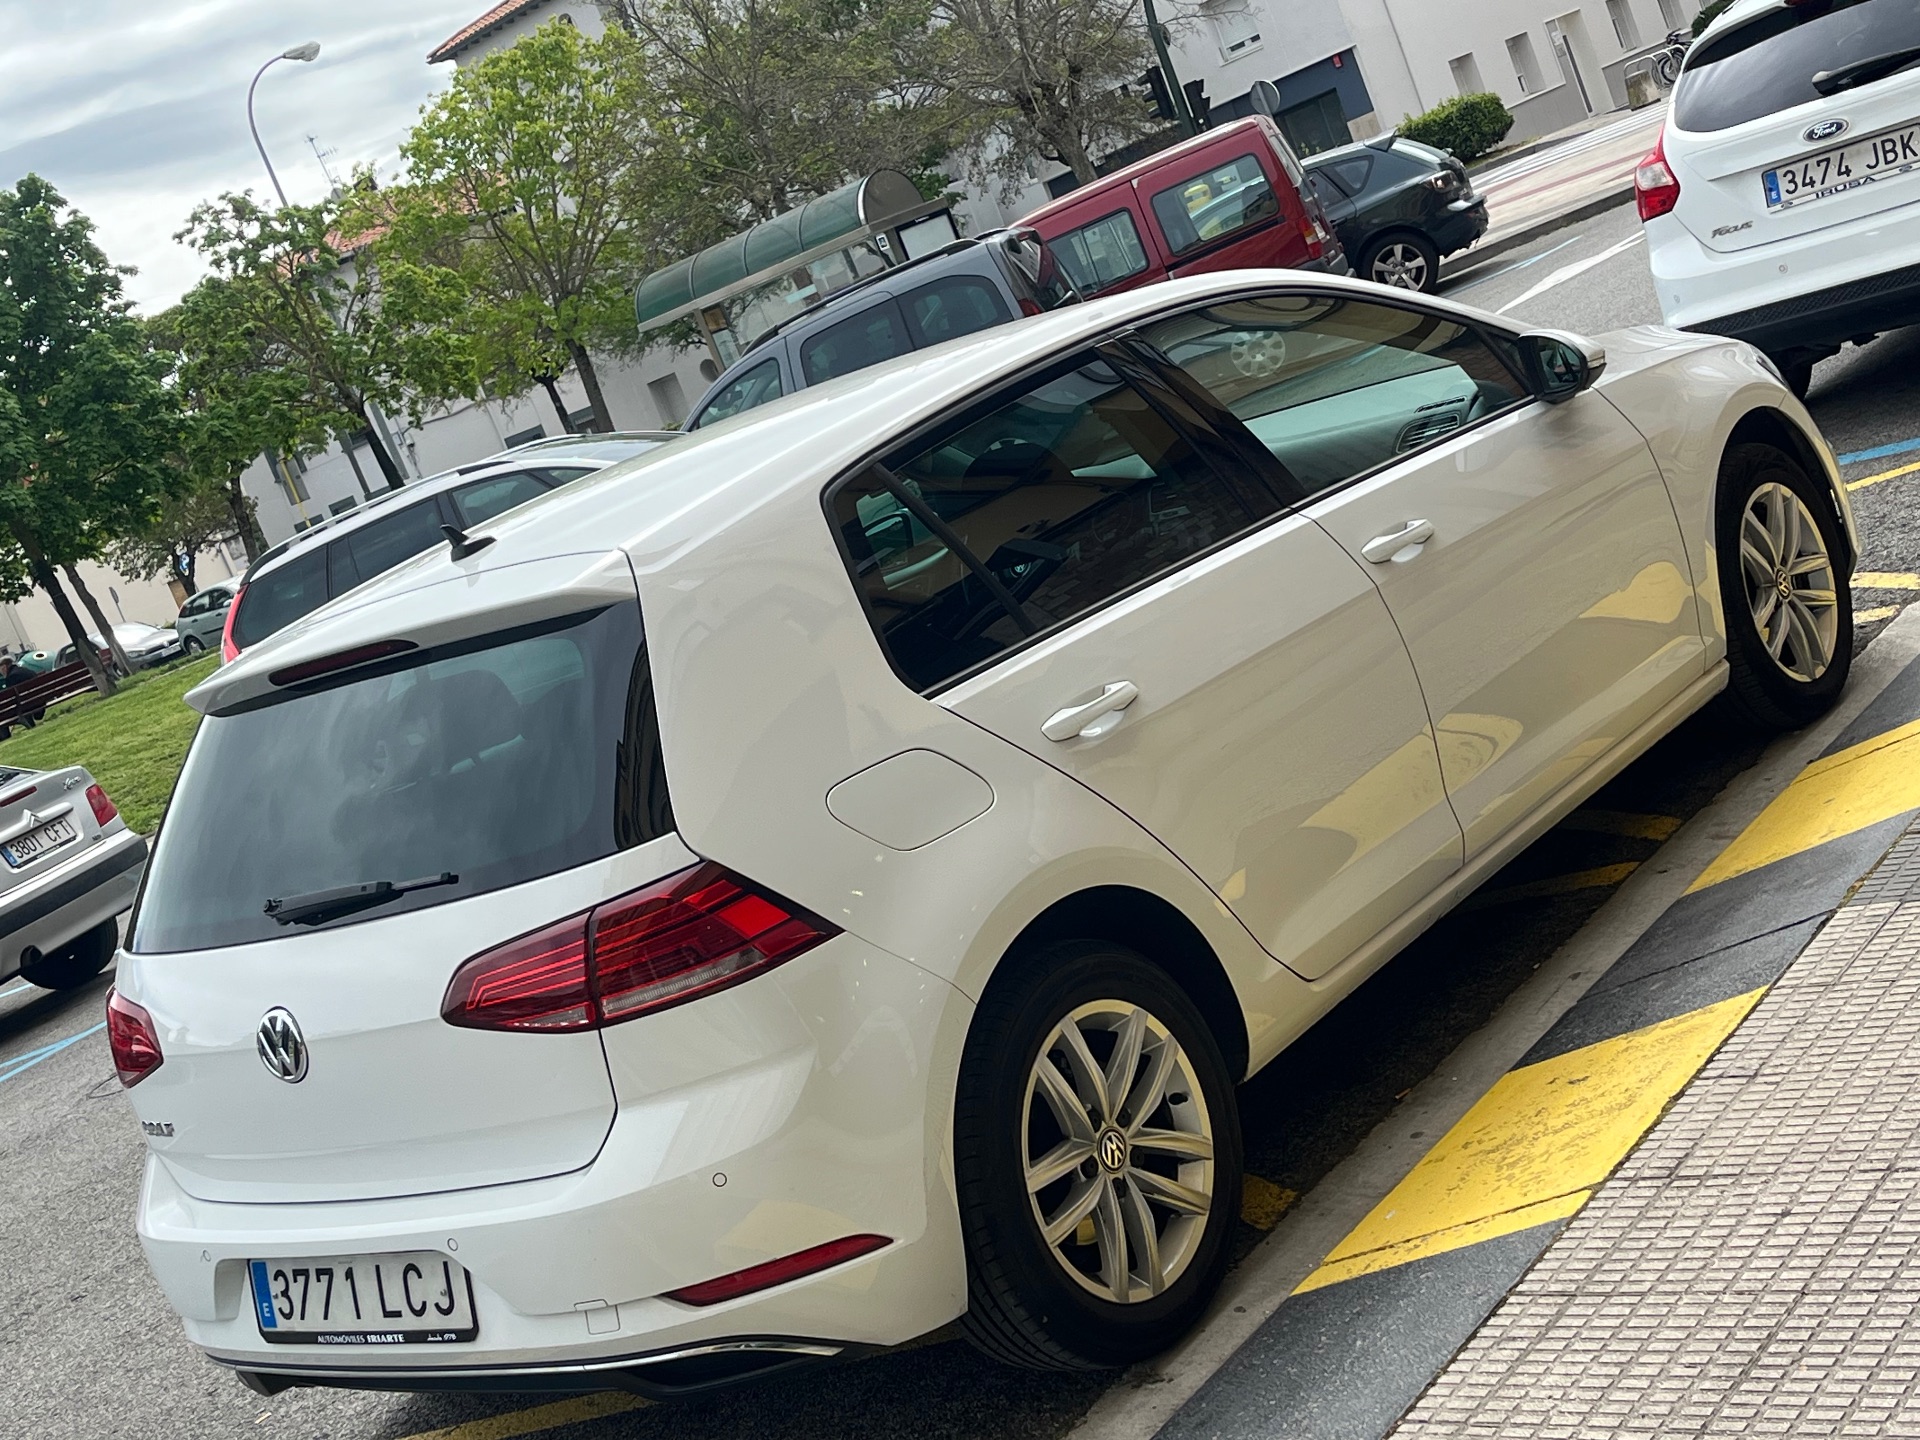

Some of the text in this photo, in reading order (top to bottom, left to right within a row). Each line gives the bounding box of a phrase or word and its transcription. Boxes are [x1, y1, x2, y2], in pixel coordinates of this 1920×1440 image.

[1782, 130, 1919, 195] 3474 JBK
[10, 820, 71, 859] 3801 CFT
[262, 1302, 271, 1317] E
[273, 1260, 455, 1321] 3771 LCJ
[366, 1333, 405, 1343] IRIARTE
